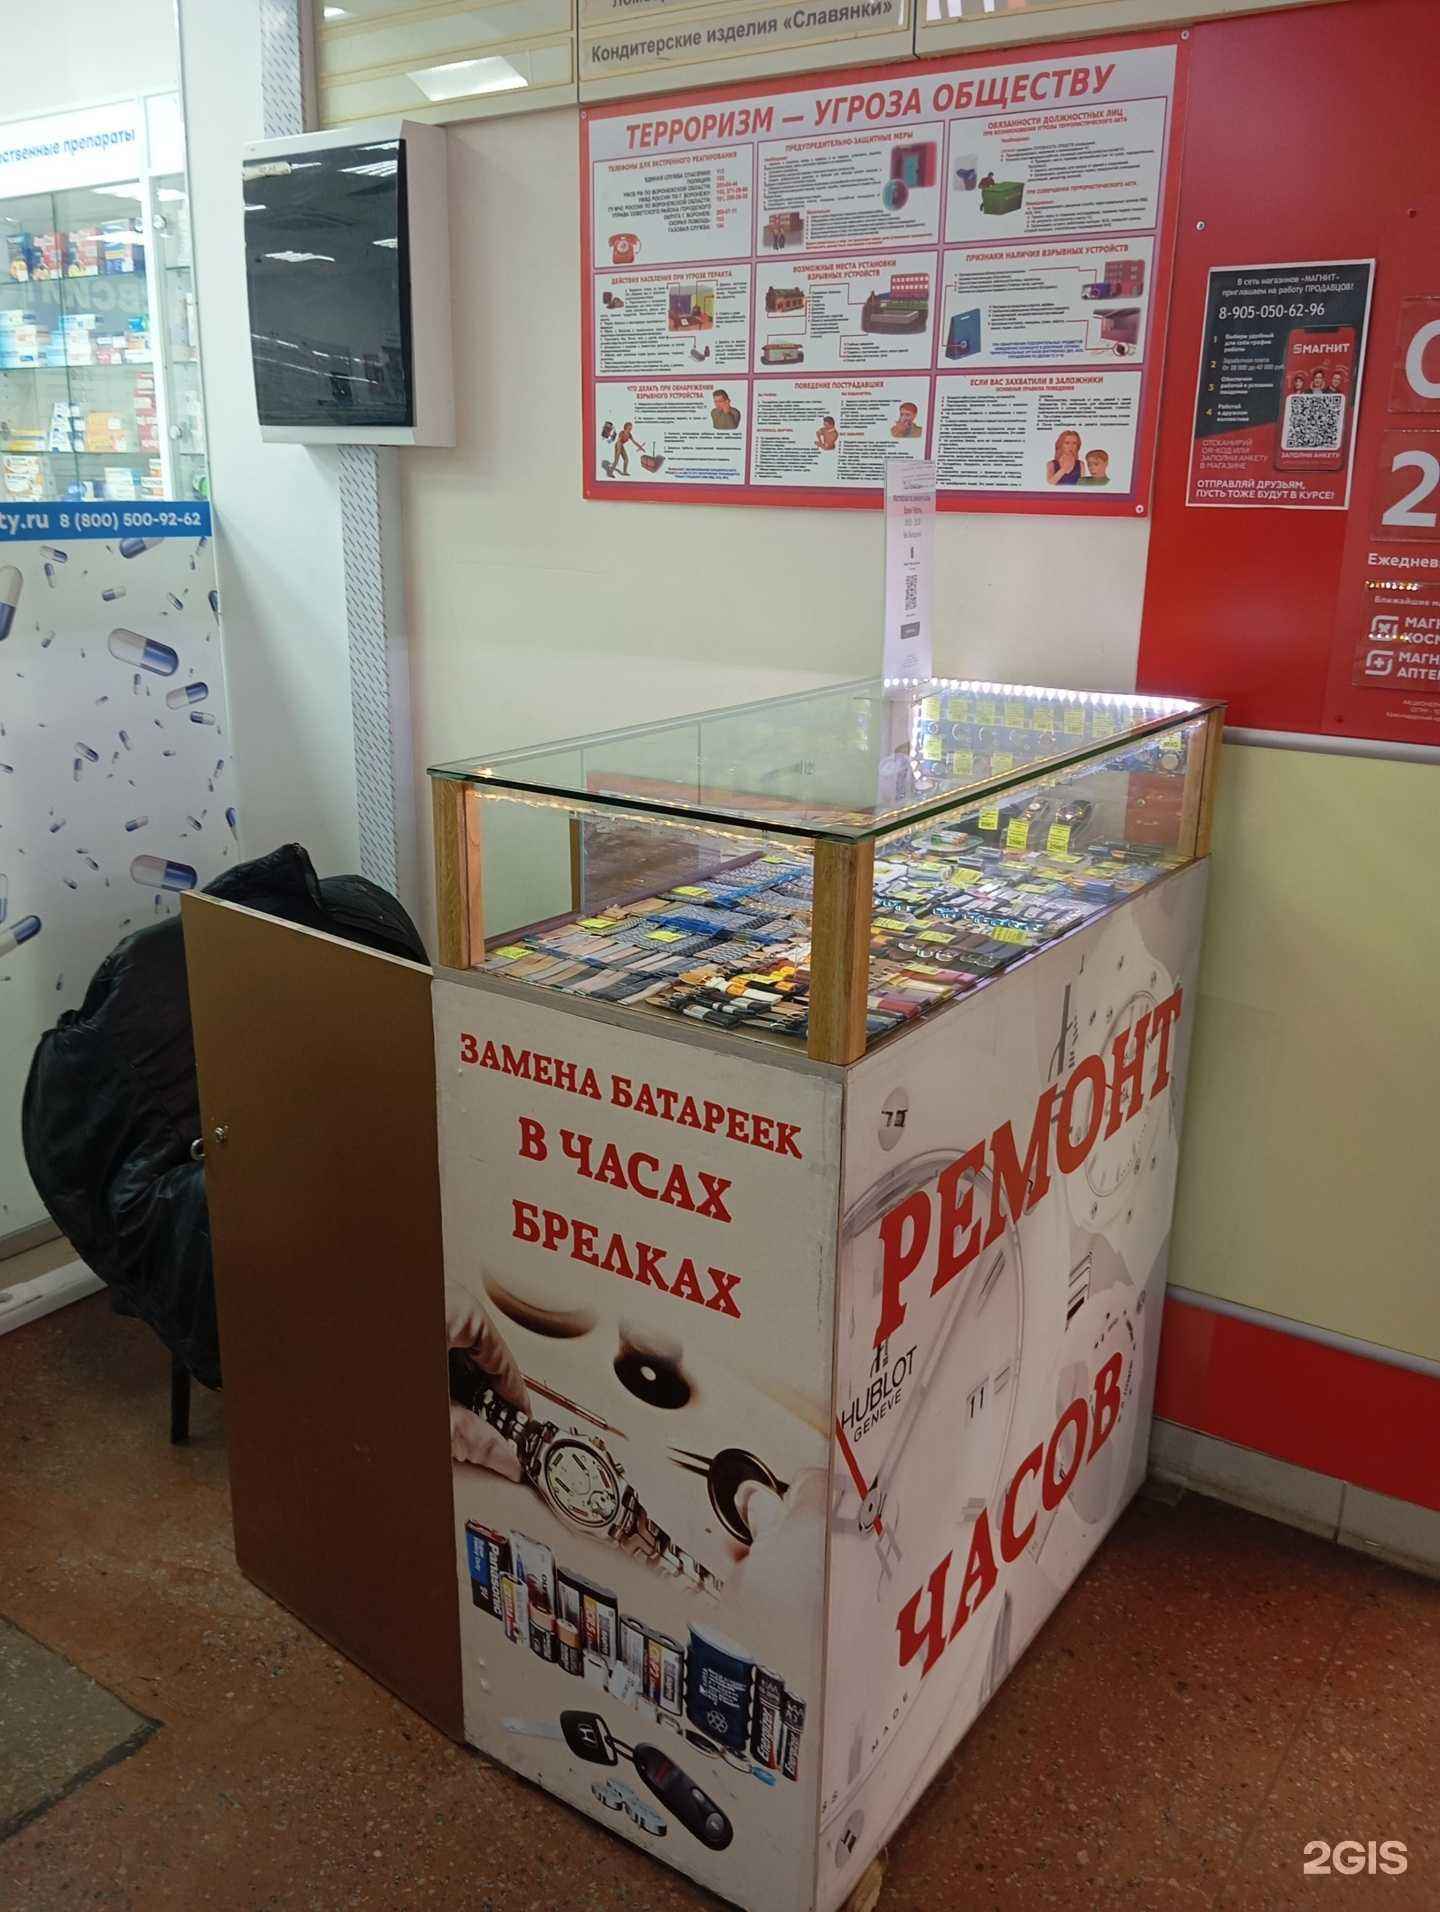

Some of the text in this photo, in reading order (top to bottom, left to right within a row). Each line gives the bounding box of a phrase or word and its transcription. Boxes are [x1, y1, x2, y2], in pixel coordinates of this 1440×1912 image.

[591, 0, 893, 63] Кондитерские изделия «Славянки»
[63, 129, 136, 156] препараты
[626, 106, 774, 150] ТЕРРОРИЗМ
[814, 87, 922, 127] УГРОЗА
[932, 63, 1116, 112] ОБЩЕСТВУ
[1217, 302, 1325, 320] 8-905-050-62-96
[1196, 479, 1256, 489] ОТПРАВЛЯЙ
[1196, 489, 1226, 498] ПУСТЬ
[1227, 490, 1256, 499] ТОЖЕ
[1257, 490, 1289, 499] БУДУТ
[1299, 491, 1335, 500] КУРСЕ!
[59, 513, 70, 528] 8
[74, 511, 119, 533] (800)
[123, 511, 202, 528] 500-92-62
[460, 1032, 803, 1160] ЗАМЕНА БАТАРЕЕК
[518, 1116, 732, 1223] В ЧАСАХ
[873, 987, 1183, 1350] РЕМОНТ
[511, 1198, 742, 1319] БРЕЛКАХ
[841, 1344, 918, 1429] HUBLOT
[853, 1388, 903, 1442] GENEVE
[896, 1351, 1123, 1680] ЧАСОВ
